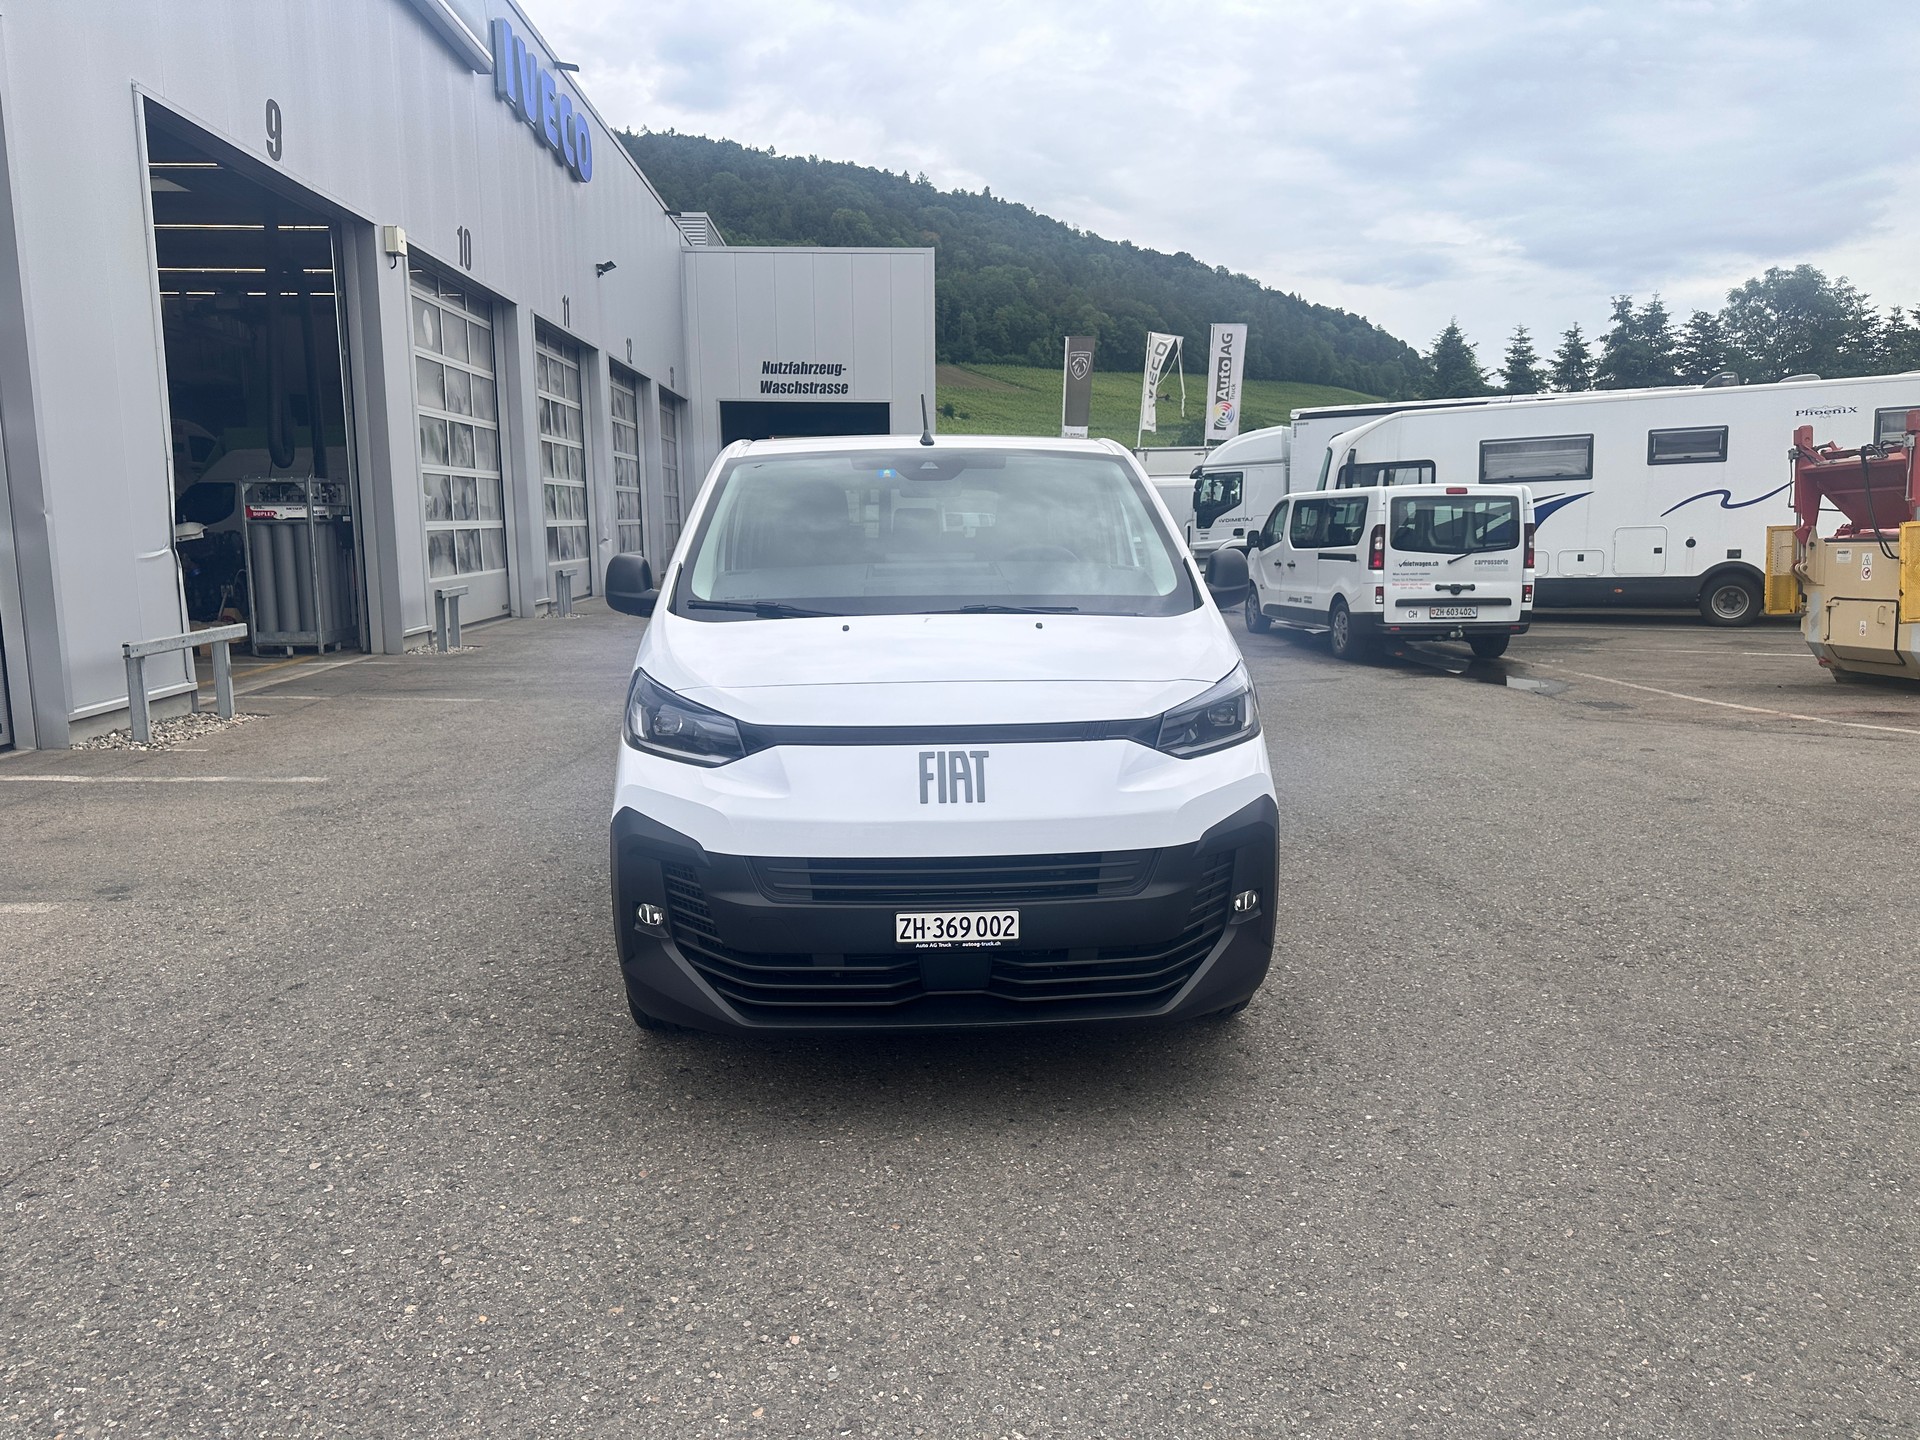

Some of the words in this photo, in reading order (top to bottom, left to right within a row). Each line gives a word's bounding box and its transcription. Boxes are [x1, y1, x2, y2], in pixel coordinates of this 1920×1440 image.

[493, 17, 593, 183] IVECO
[265, 98, 283, 162] 9
[456, 225, 472, 271] 10
[561, 294, 570, 329] 11
[1221, 332, 1233, 355] AG
[761, 361, 848, 376] Nutzfahrzeug-
[1216, 358, 1232, 400] Auto
[760, 380, 849, 395] Waschstrasse
[1474, 558, 1509, 566] carrosserie
[1408, 610, 1418, 619] CH
[919, 750, 989, 804] FIAT
